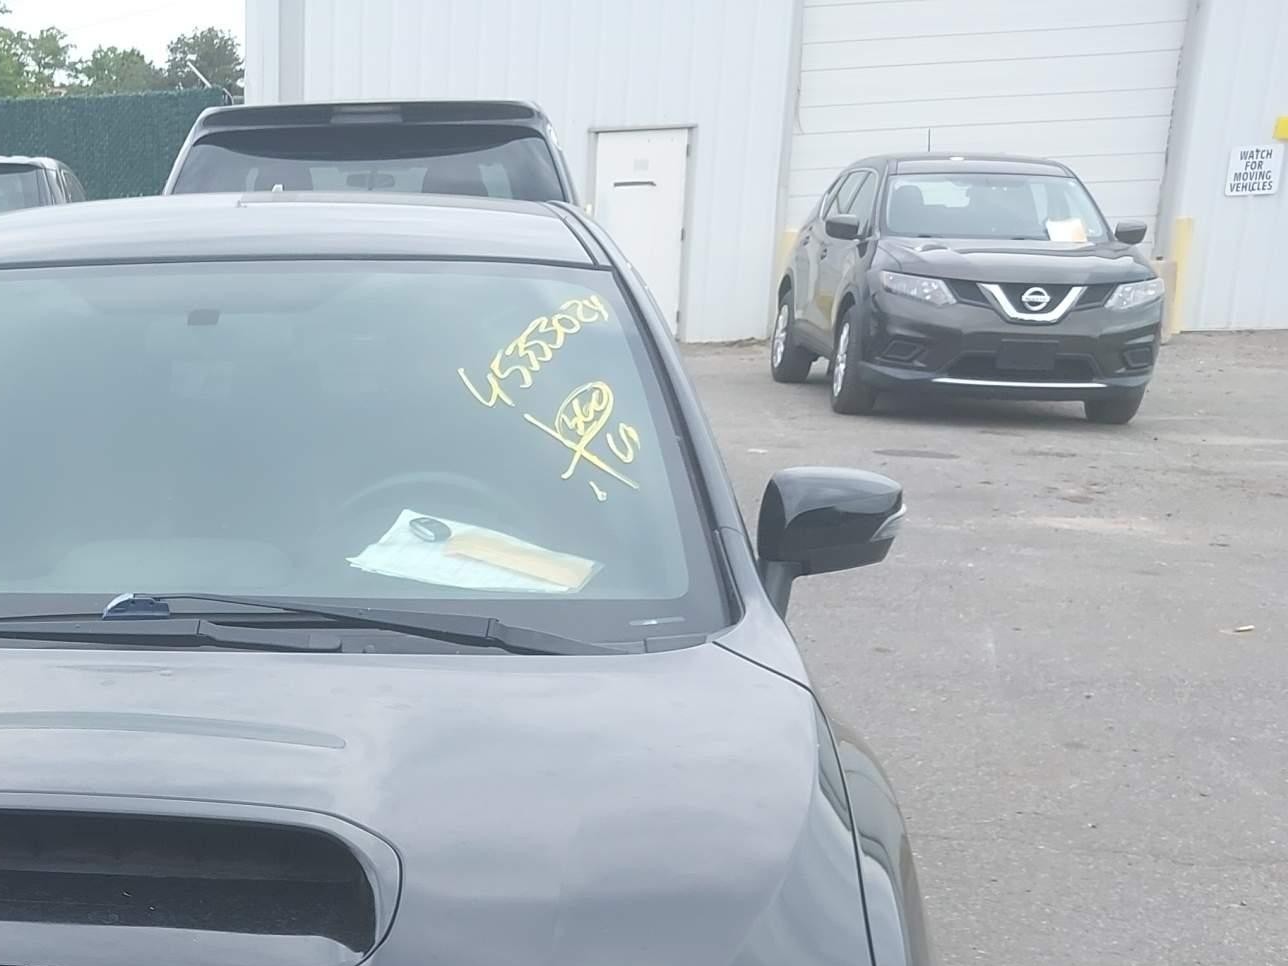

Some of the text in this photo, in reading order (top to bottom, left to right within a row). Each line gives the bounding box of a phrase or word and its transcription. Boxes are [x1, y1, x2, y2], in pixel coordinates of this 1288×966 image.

[1239, 148, 1273, 161] WATCH
[1244, 160, 1264, 171] FOR
[1233, 170, 1272, 182] MOVING
[1229, 181, 1273, 193] VEHICLES
